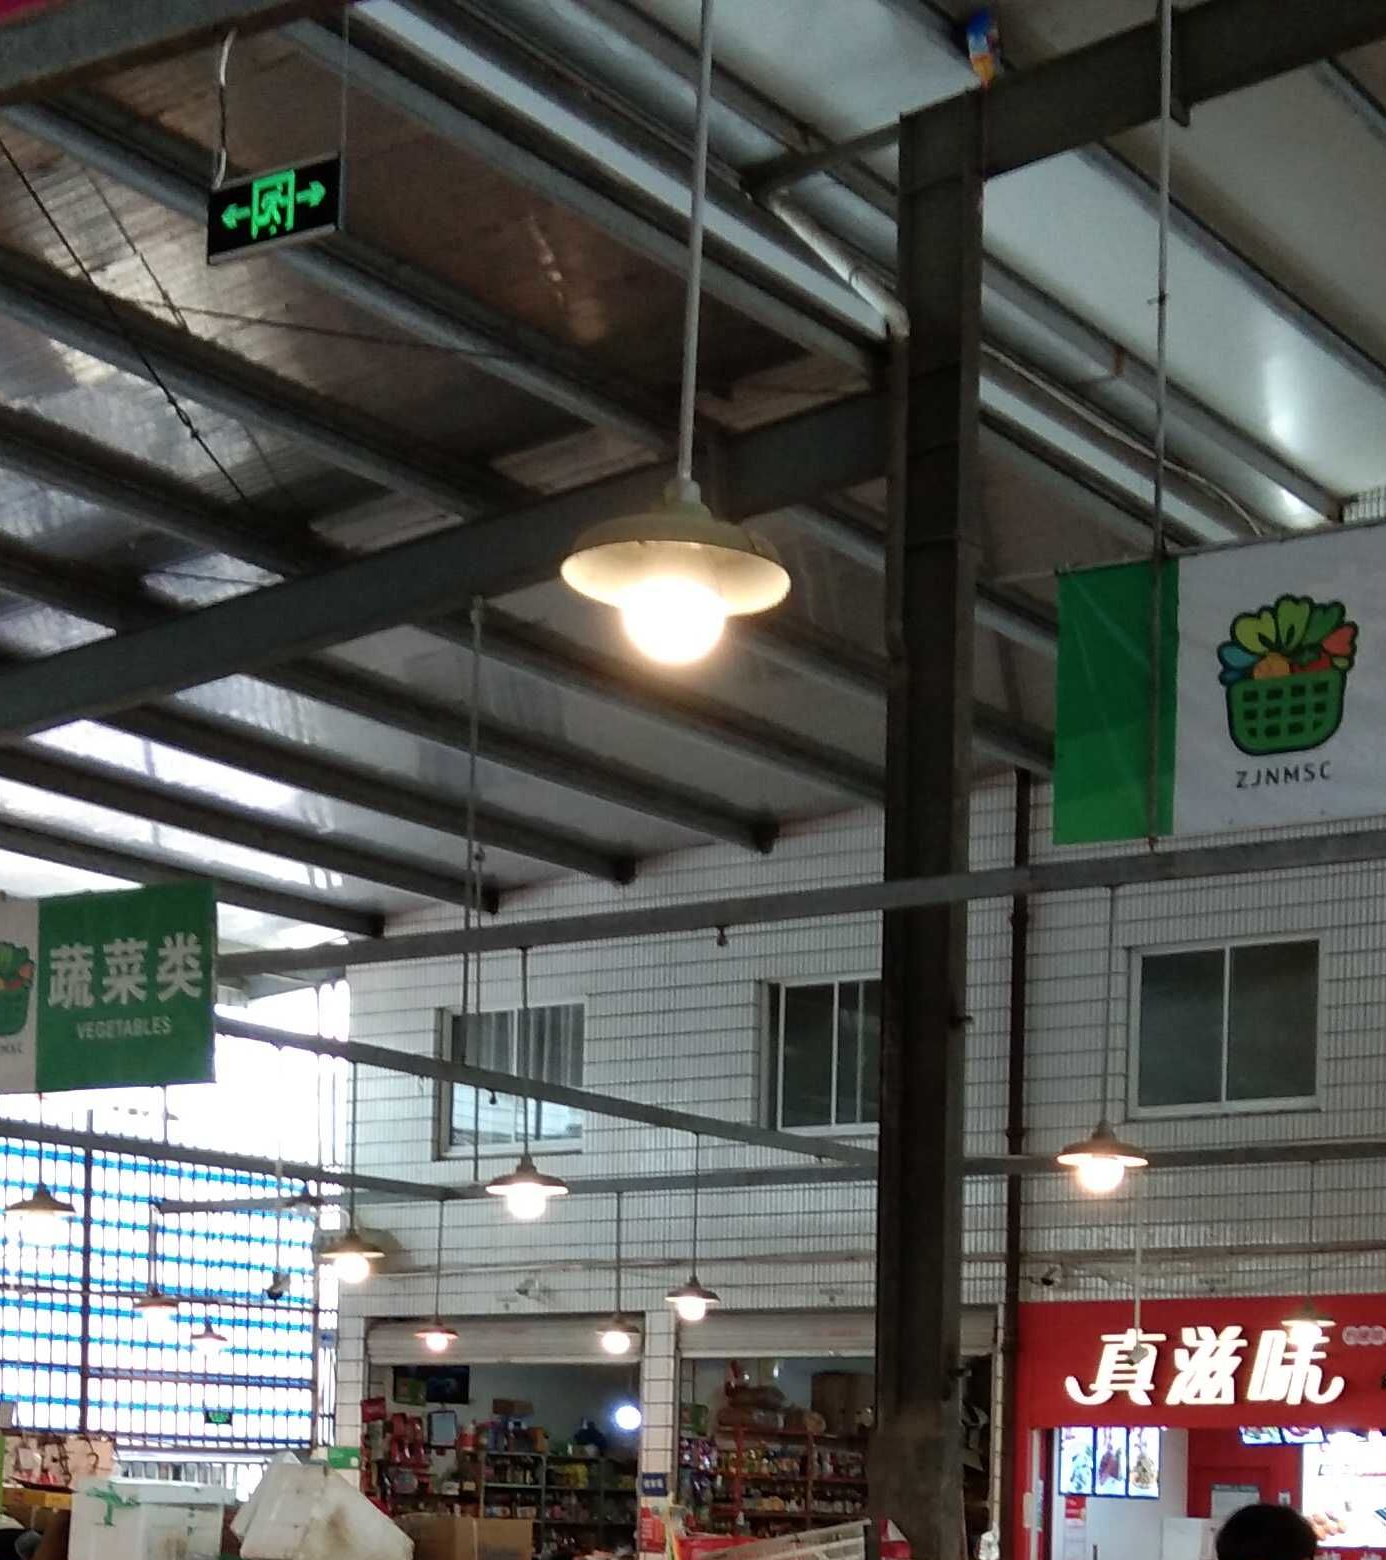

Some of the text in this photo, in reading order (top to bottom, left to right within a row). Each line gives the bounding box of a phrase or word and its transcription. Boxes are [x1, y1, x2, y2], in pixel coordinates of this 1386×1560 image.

[1235, 760, 1333, 789] ZJNMSC
[47, 932, 204, 1009] 蔬菜类
[76, 1016, 172, 1041] VEGETABLES
[1065, 1322, 1344, 1406] 真滋味
